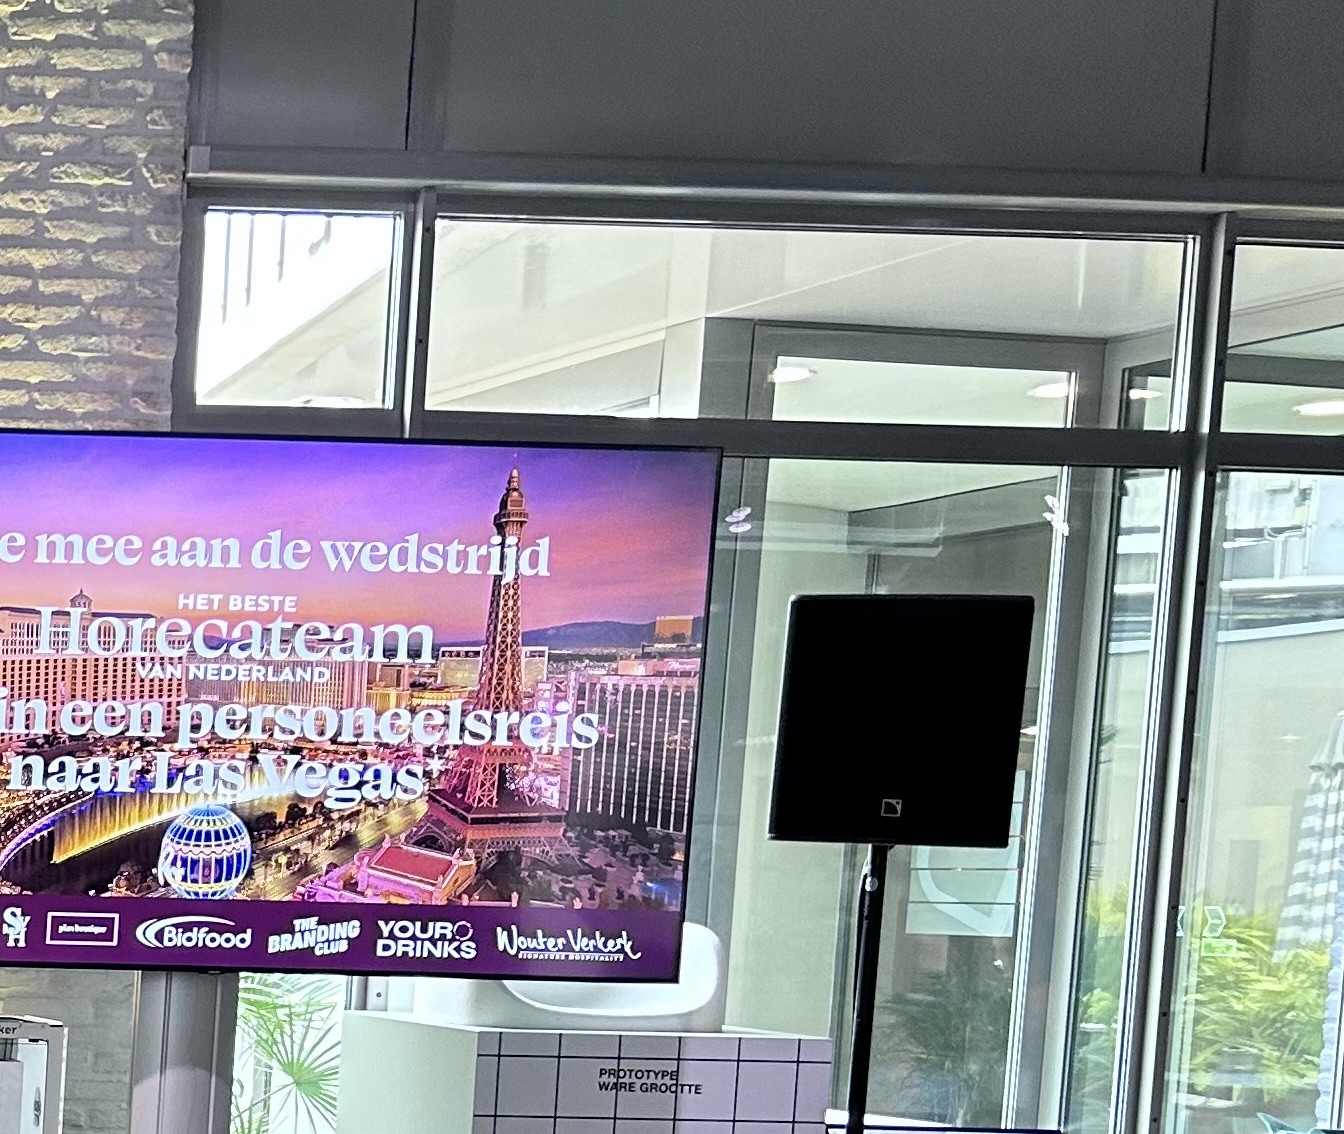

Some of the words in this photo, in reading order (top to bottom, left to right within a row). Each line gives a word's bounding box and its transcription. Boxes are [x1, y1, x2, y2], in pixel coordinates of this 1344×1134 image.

[33, 532, 143, 566] mee
[151, 536, 241, 568] aan
[251, 529, 312, 571] de
[314, 534, 552, 585] wedstrijd
[178, 593, 223, 612] HET
[228, 594, 298, 614] BESTE
[33, 606, 435, 665] Horecateam
[136, 662, 186, 680] VAN
[189, 664, 330, 684] NEDERLAND
[61, 698, 166, 737] een
[178, 696, 600, 752] personeelsreis
[8, 751, 143, 794] naar
[151, 752, 247, 797] Las
[293, 916, 319, 932] THE
[163, 926, 252, 949] Bidfood
[267, 919, 361, 954] BRANDING
[314, 939, 349, 956] CLUB
[496, 924, 566, 955] Wouter
[566, 928, 642, 960] Verkerk
[376, 938, 478, 959] DRINKS
[599, 1068, 679, 1081] PROTOTYPE
[598, 1081, 636, 1093] WARE
